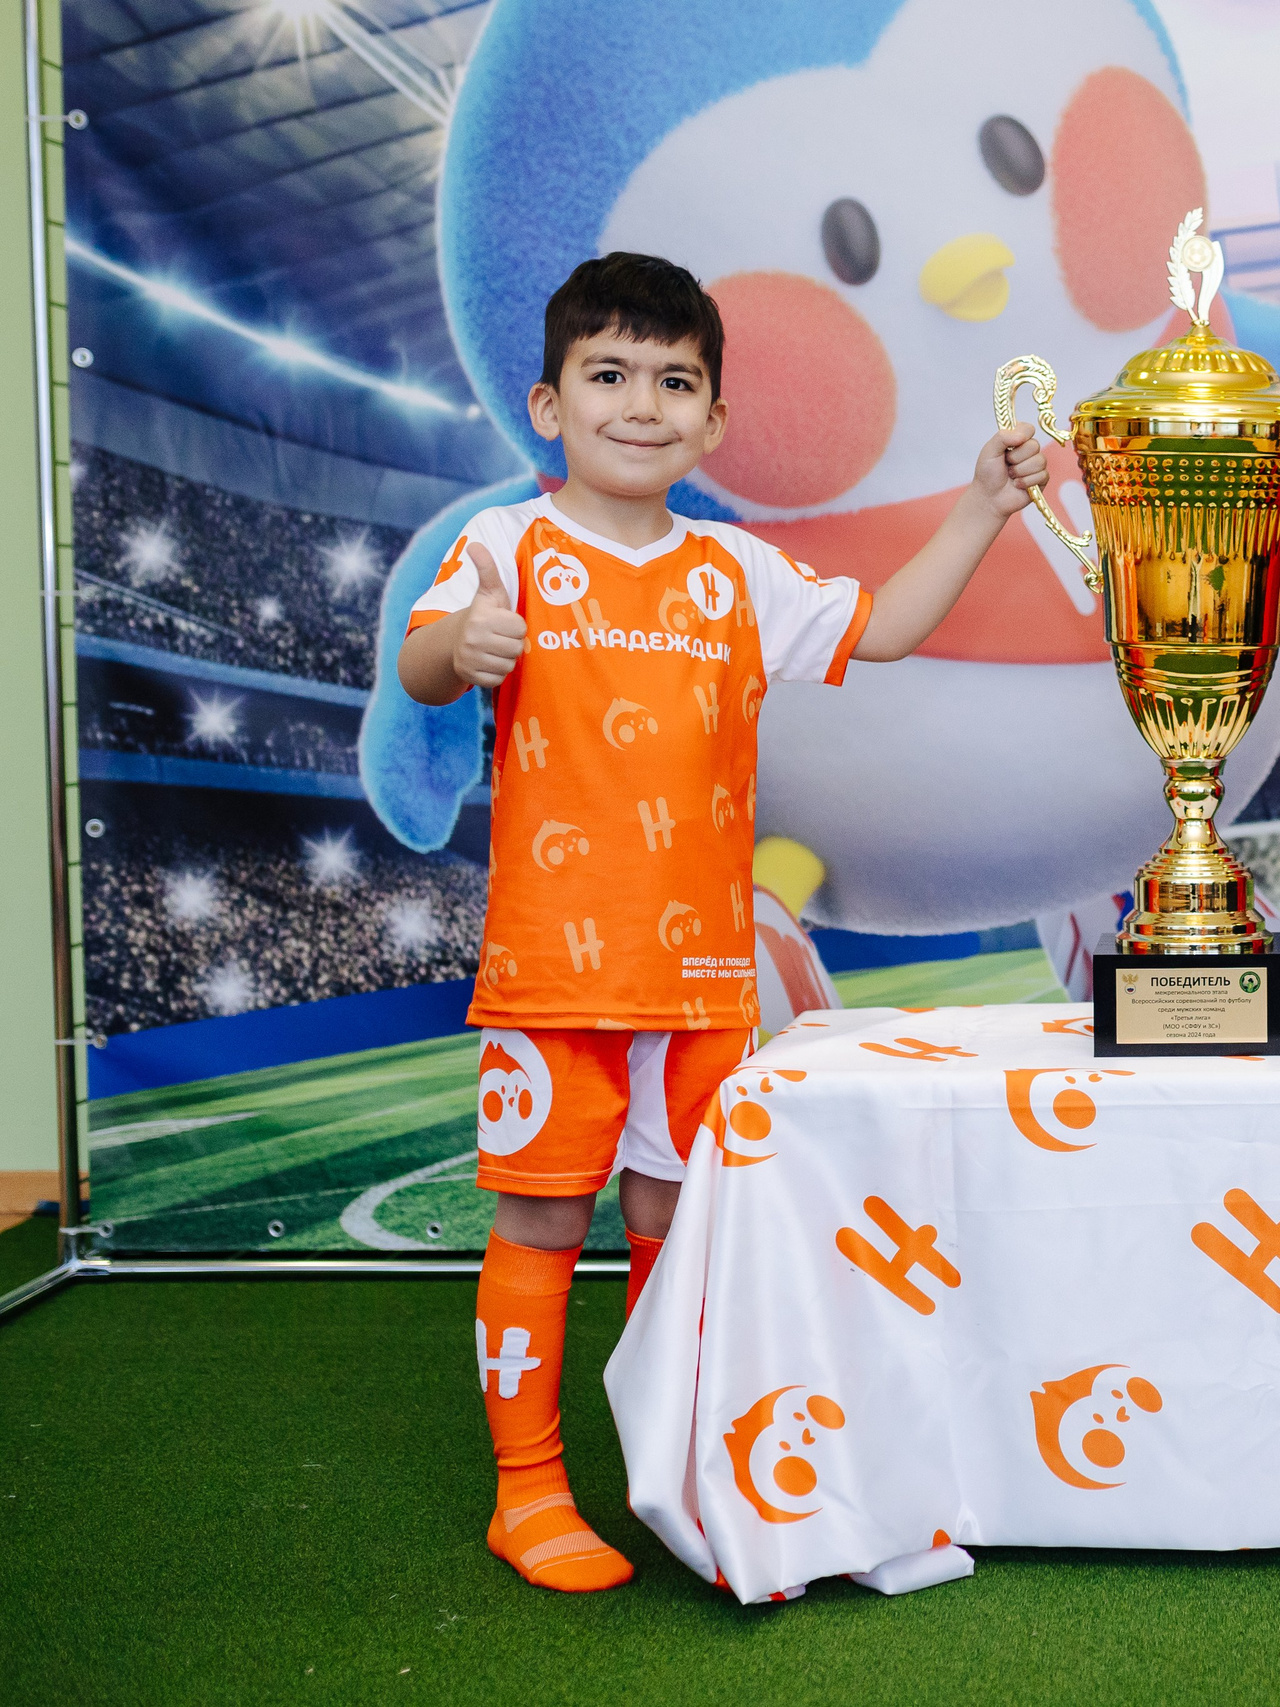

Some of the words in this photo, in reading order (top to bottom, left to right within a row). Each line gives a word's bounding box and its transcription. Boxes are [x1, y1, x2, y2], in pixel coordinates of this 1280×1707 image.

[537, 628, 582, 650] ФК
[588, 627, 731, 665] НАДЕЖДИК
[682, 955, 718, 968] ВПЕРЁД
[719, 957, 725, 966] К
[682, 969, 716, 978] ВМЕСТЕ
[717, 969, 731, 978] МЫ
[1150, 976, 1231, 989] ПОБЕДИТЕЛЬ
